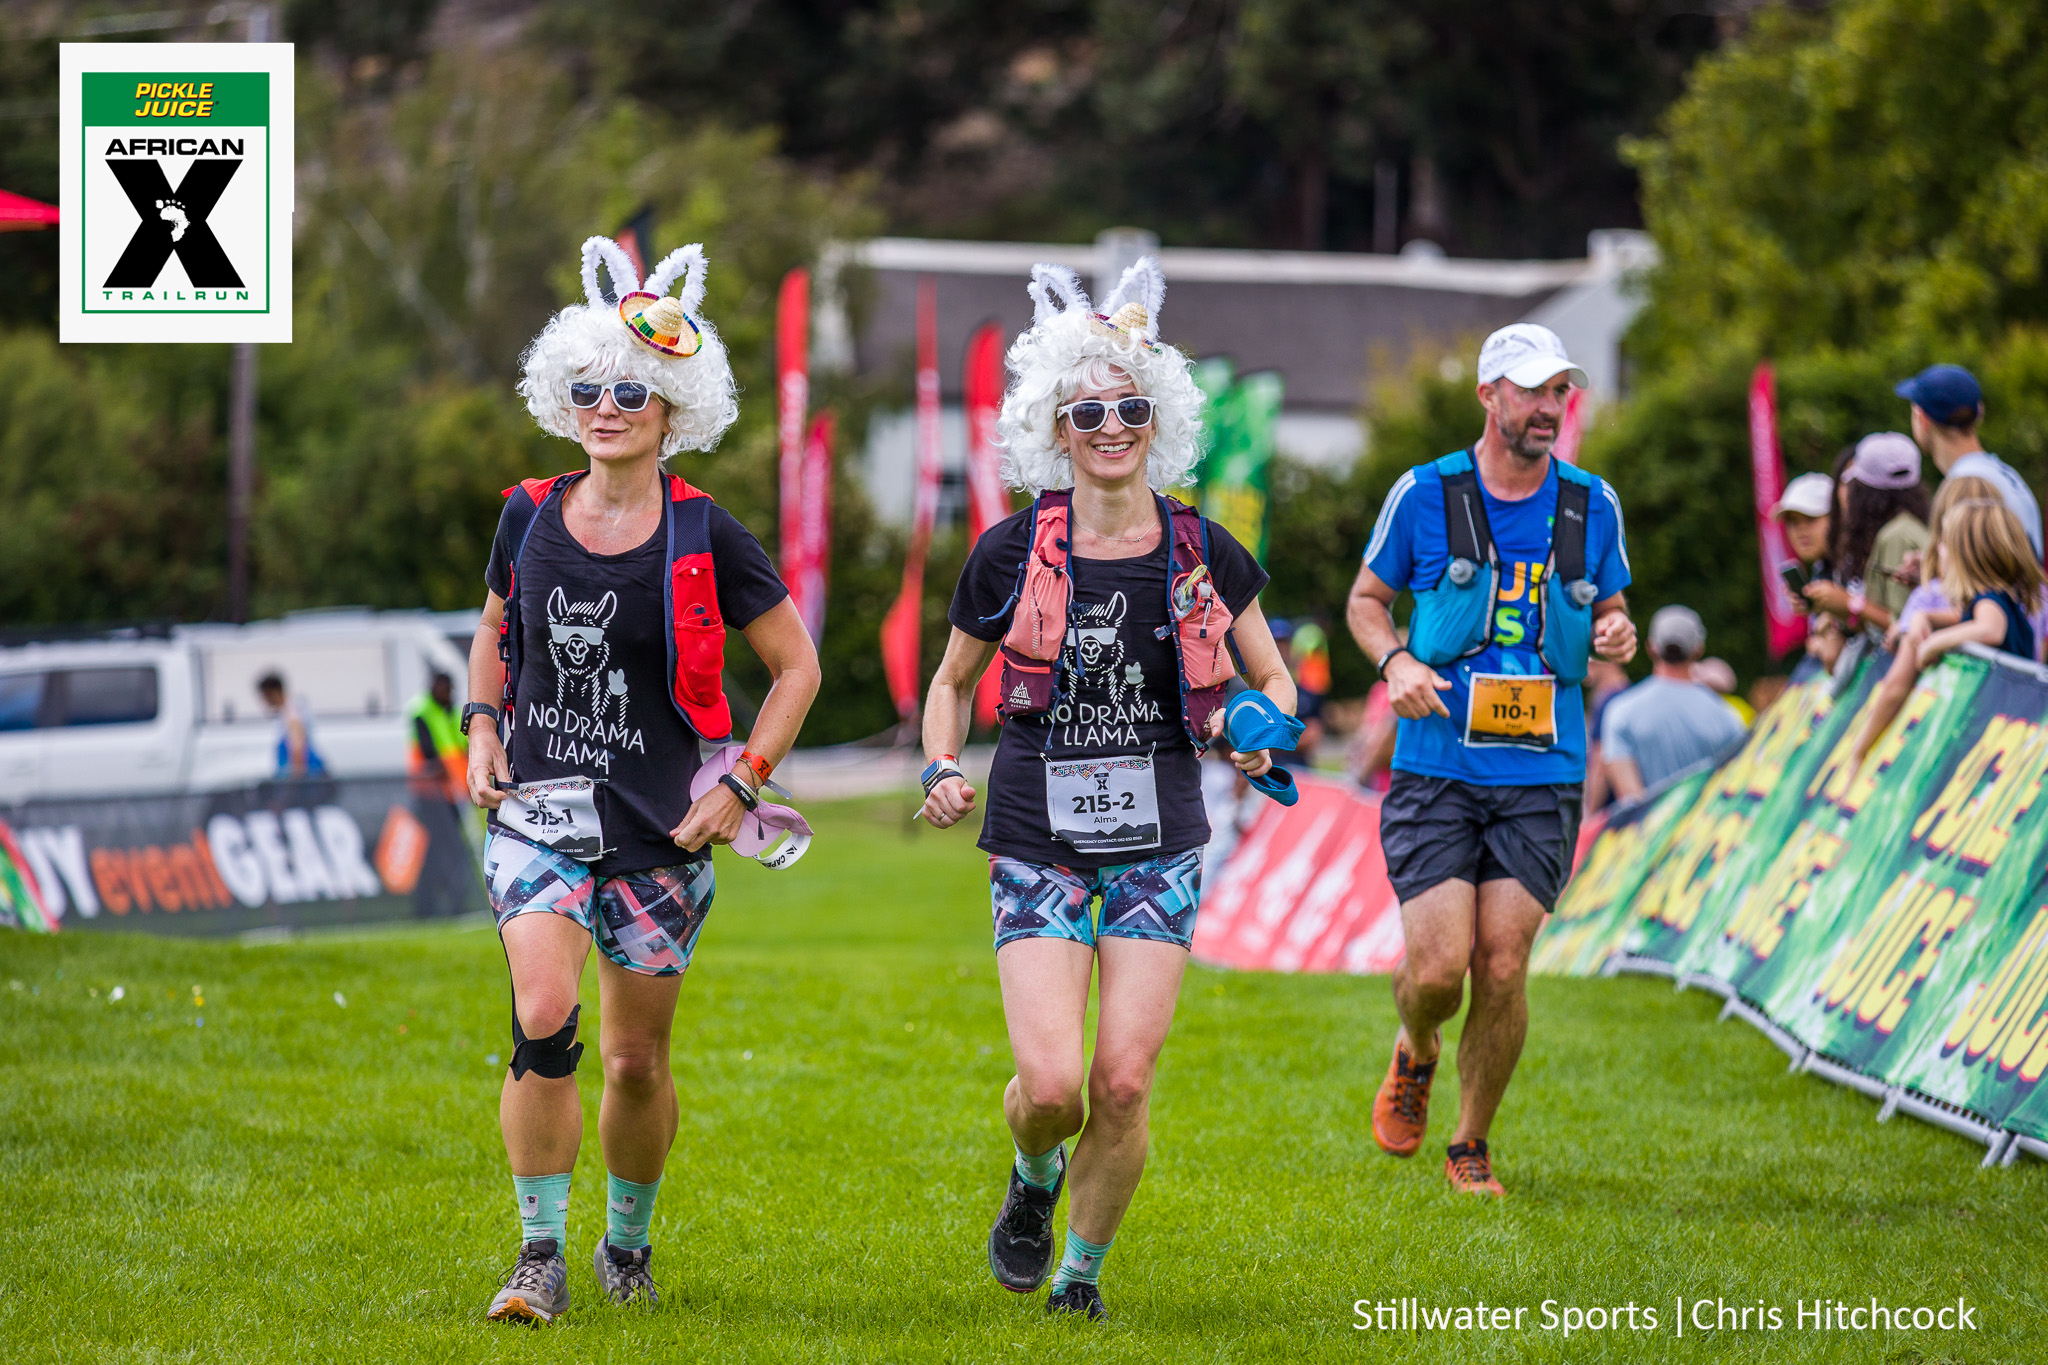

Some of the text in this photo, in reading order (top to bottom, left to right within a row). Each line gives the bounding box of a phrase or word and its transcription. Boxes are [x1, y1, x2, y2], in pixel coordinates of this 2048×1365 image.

[1079, 700, 1163, 726] DRAMA
[1492, 704, 1536, 720] 110-1
[527, 702, 645, 755] NO DRAMA
[1064, 724, 1140, 747] LLAMA
[546, 734, 609, 775] LLAMA
[1071, 792, 1135, 814] 215-2
[525, 808, 574, 826] 215-1
[1093, 816, 1118, 824] Alma
[1815, 870, 1974, 1034] JUICE
